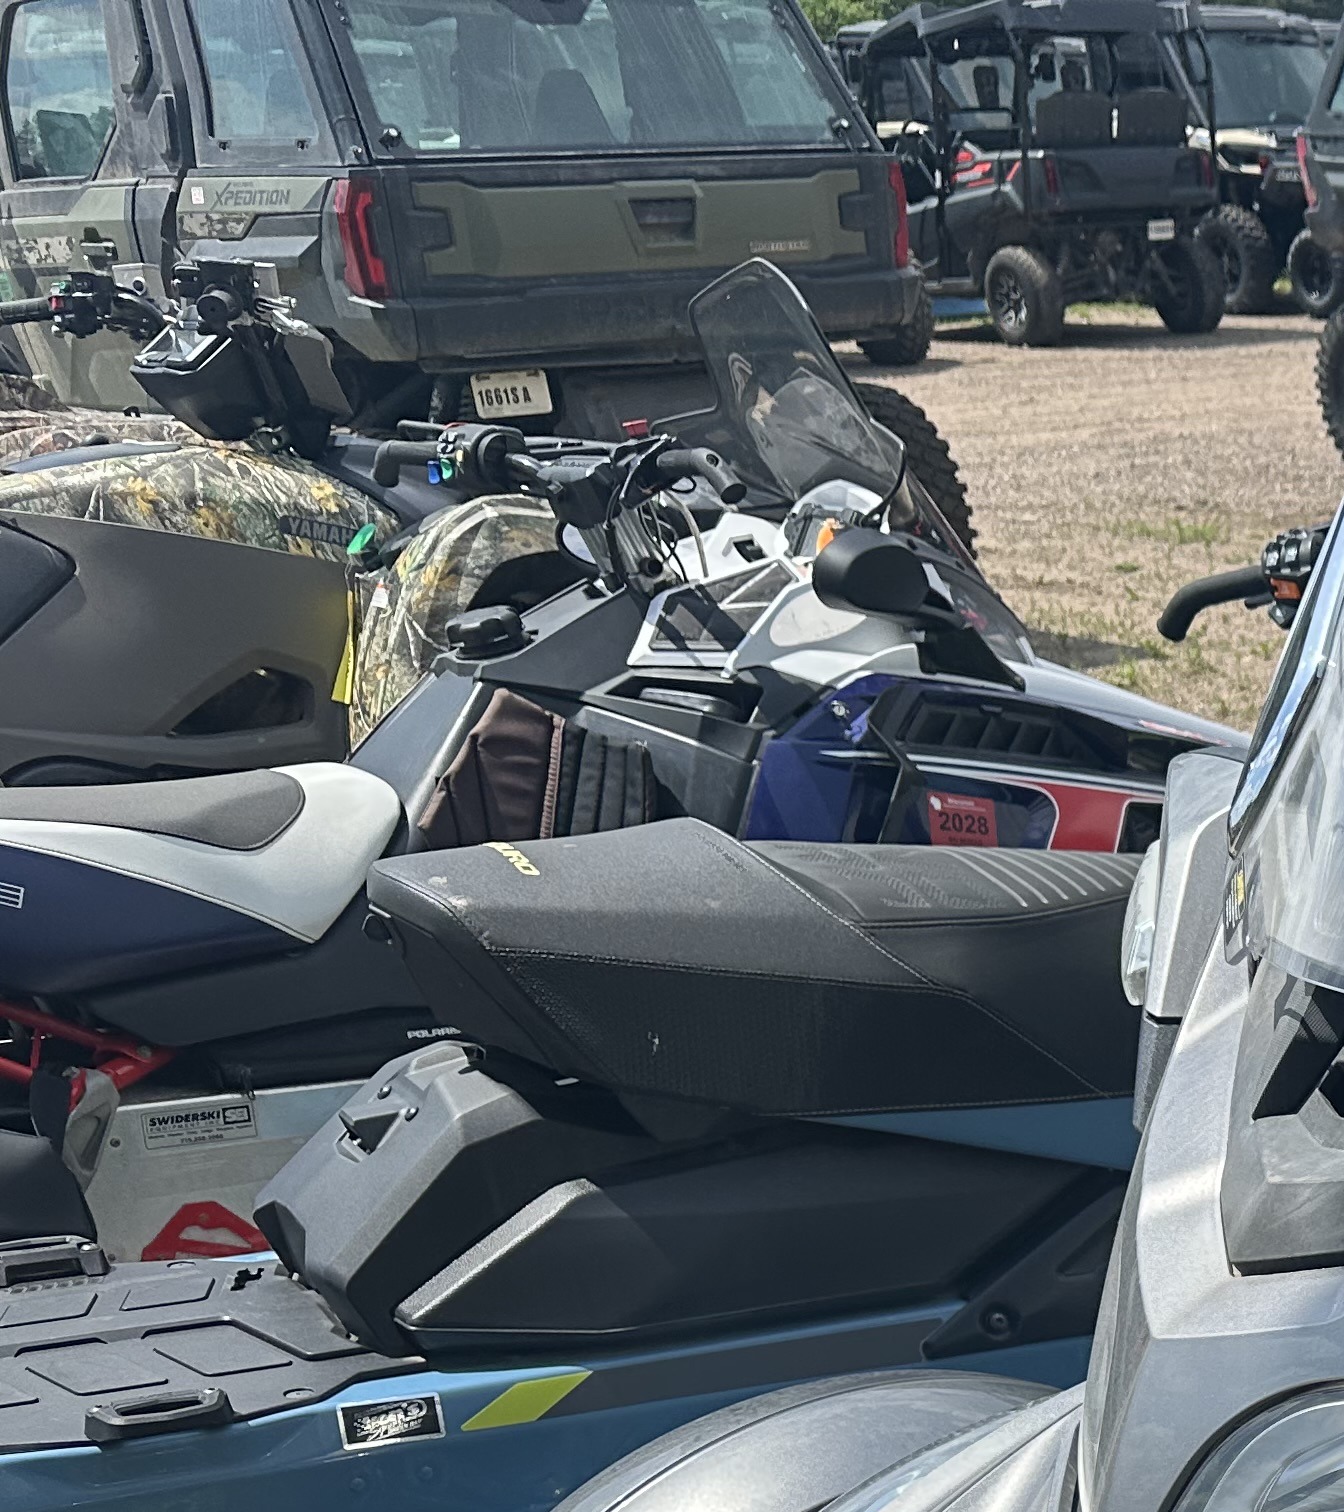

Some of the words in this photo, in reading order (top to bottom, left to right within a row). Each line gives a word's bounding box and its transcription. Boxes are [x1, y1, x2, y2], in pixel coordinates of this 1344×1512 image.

[210, 182, 291, 211] XPEDITION
[288, 517, 355, 547] YAMAH
[939, 812, 990, 835] 2028
[149, 1110, 221, 1127] SWIDERSKI
